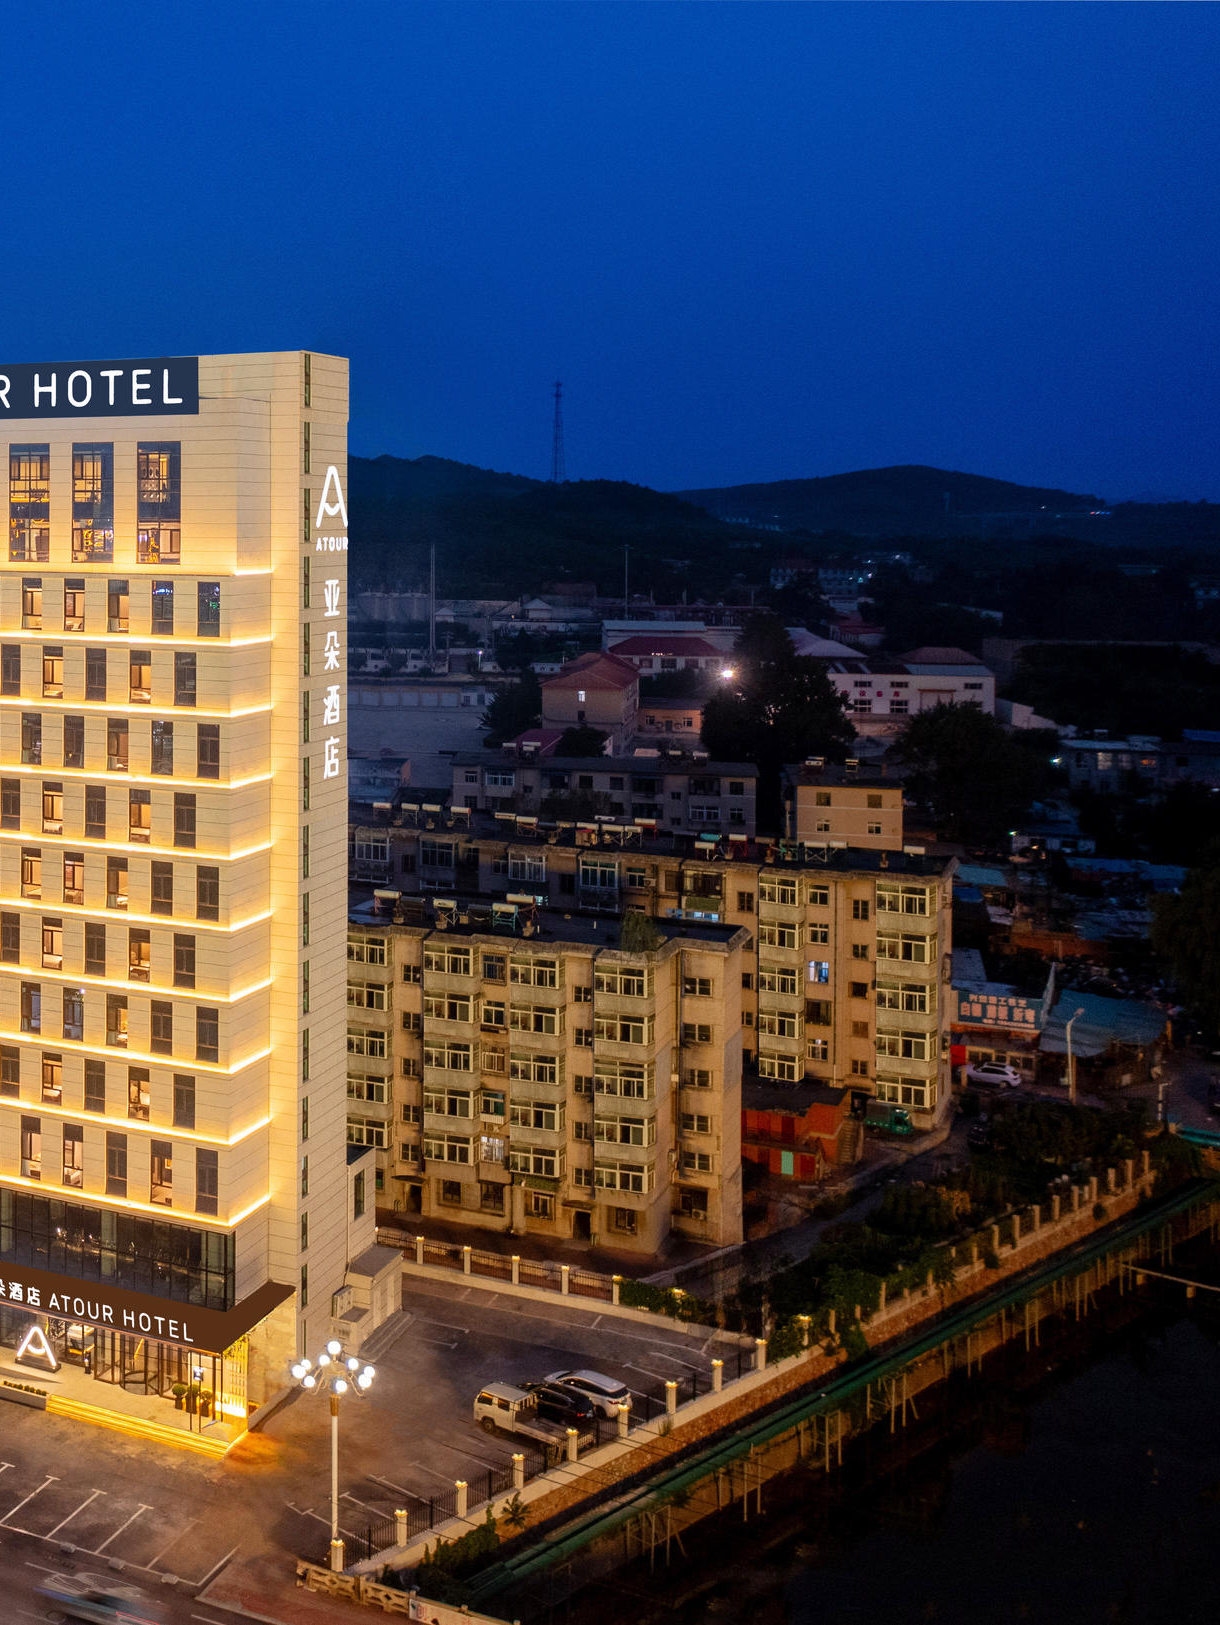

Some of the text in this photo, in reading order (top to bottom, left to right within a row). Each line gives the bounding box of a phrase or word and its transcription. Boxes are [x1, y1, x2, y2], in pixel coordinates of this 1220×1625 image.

[34, 369, 183, 407] HOTEL
[316, 537, 349, 552] ATOUR
[324, 579, 341, 779] 亚朵酒店
[48, 1292, 114, 1323] ATOUR
[123, 1309, 194, 1343] HOTEL
